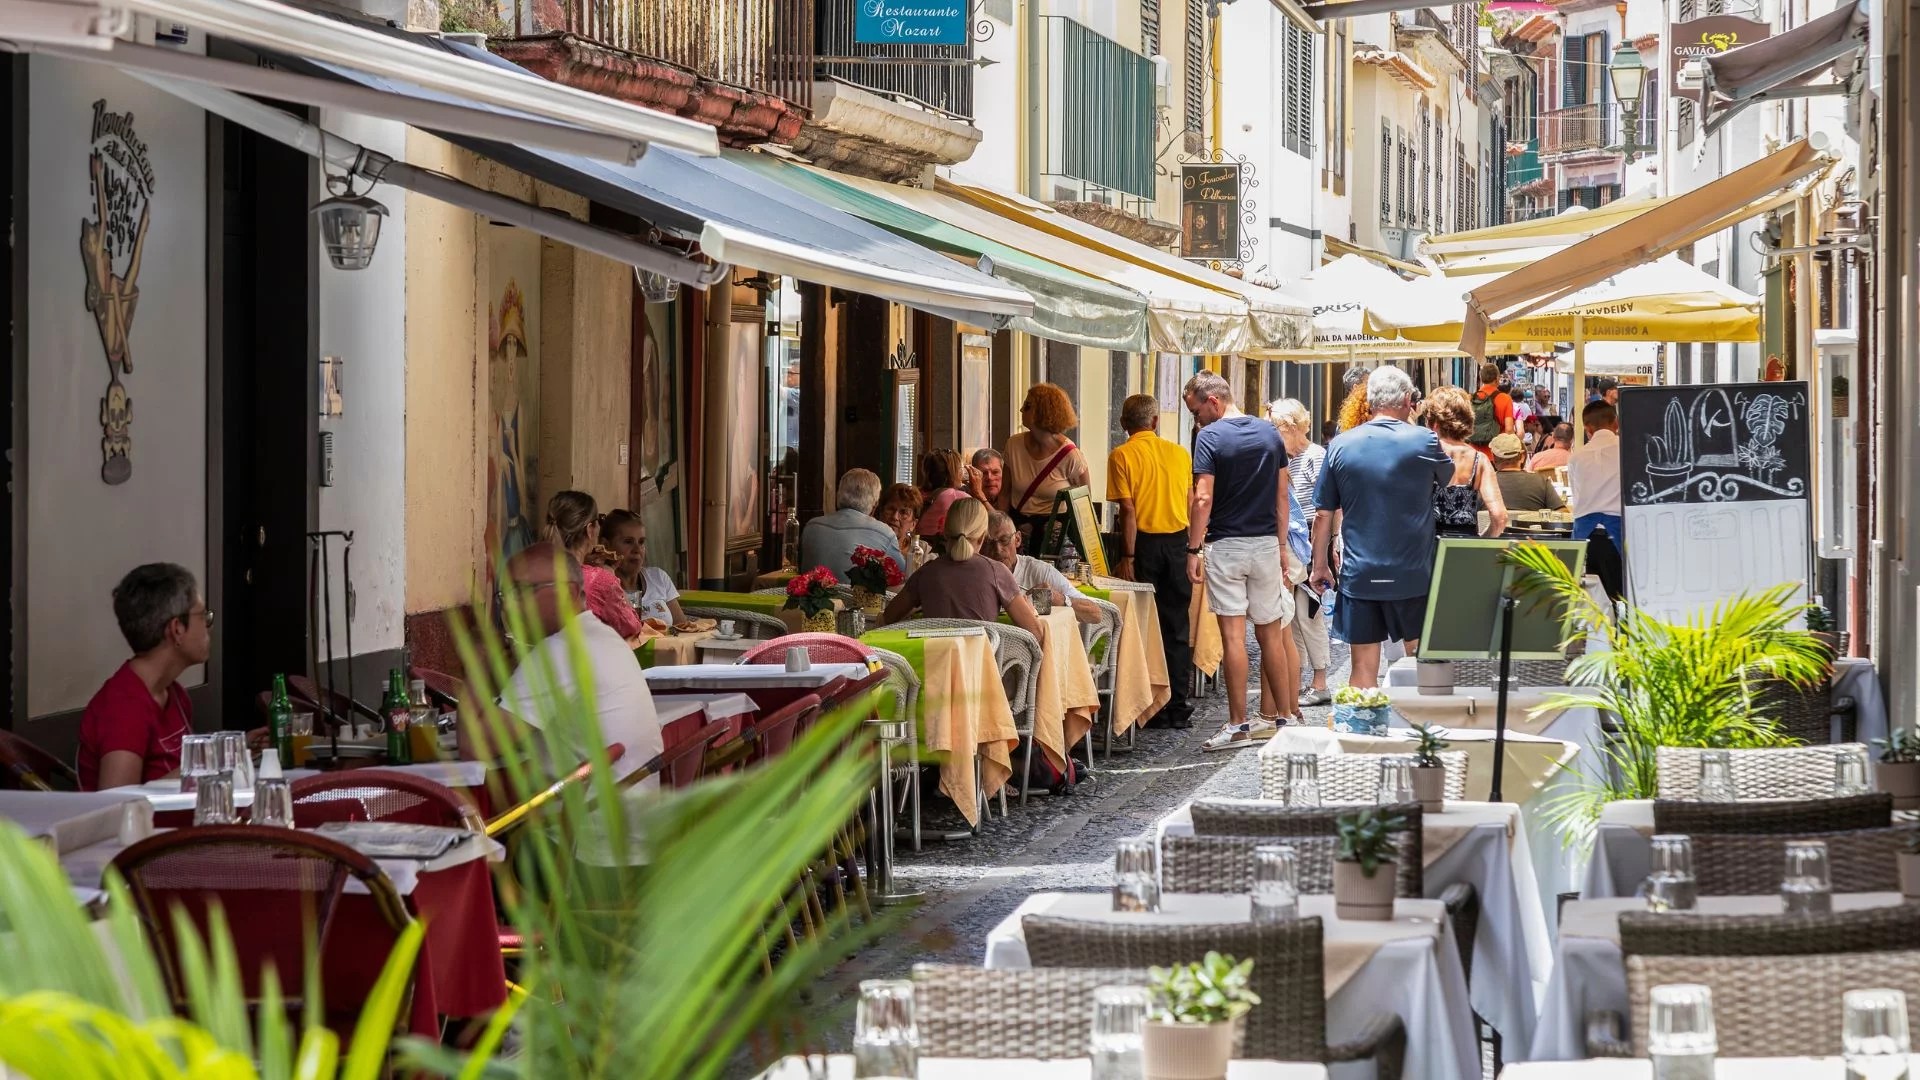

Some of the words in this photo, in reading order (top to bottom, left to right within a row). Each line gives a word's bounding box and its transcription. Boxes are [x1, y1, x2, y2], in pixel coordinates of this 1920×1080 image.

[863, 0, 960, 18] Restaurante
[881, 18, 942, 38] Mozart
[1674, 45, 1716, 56] GAVIÃO
[1313, 335, 1331, 343] INAL
[1332, 334, 1343, 342] DA
[1636, 365, 1653, 375] COR
